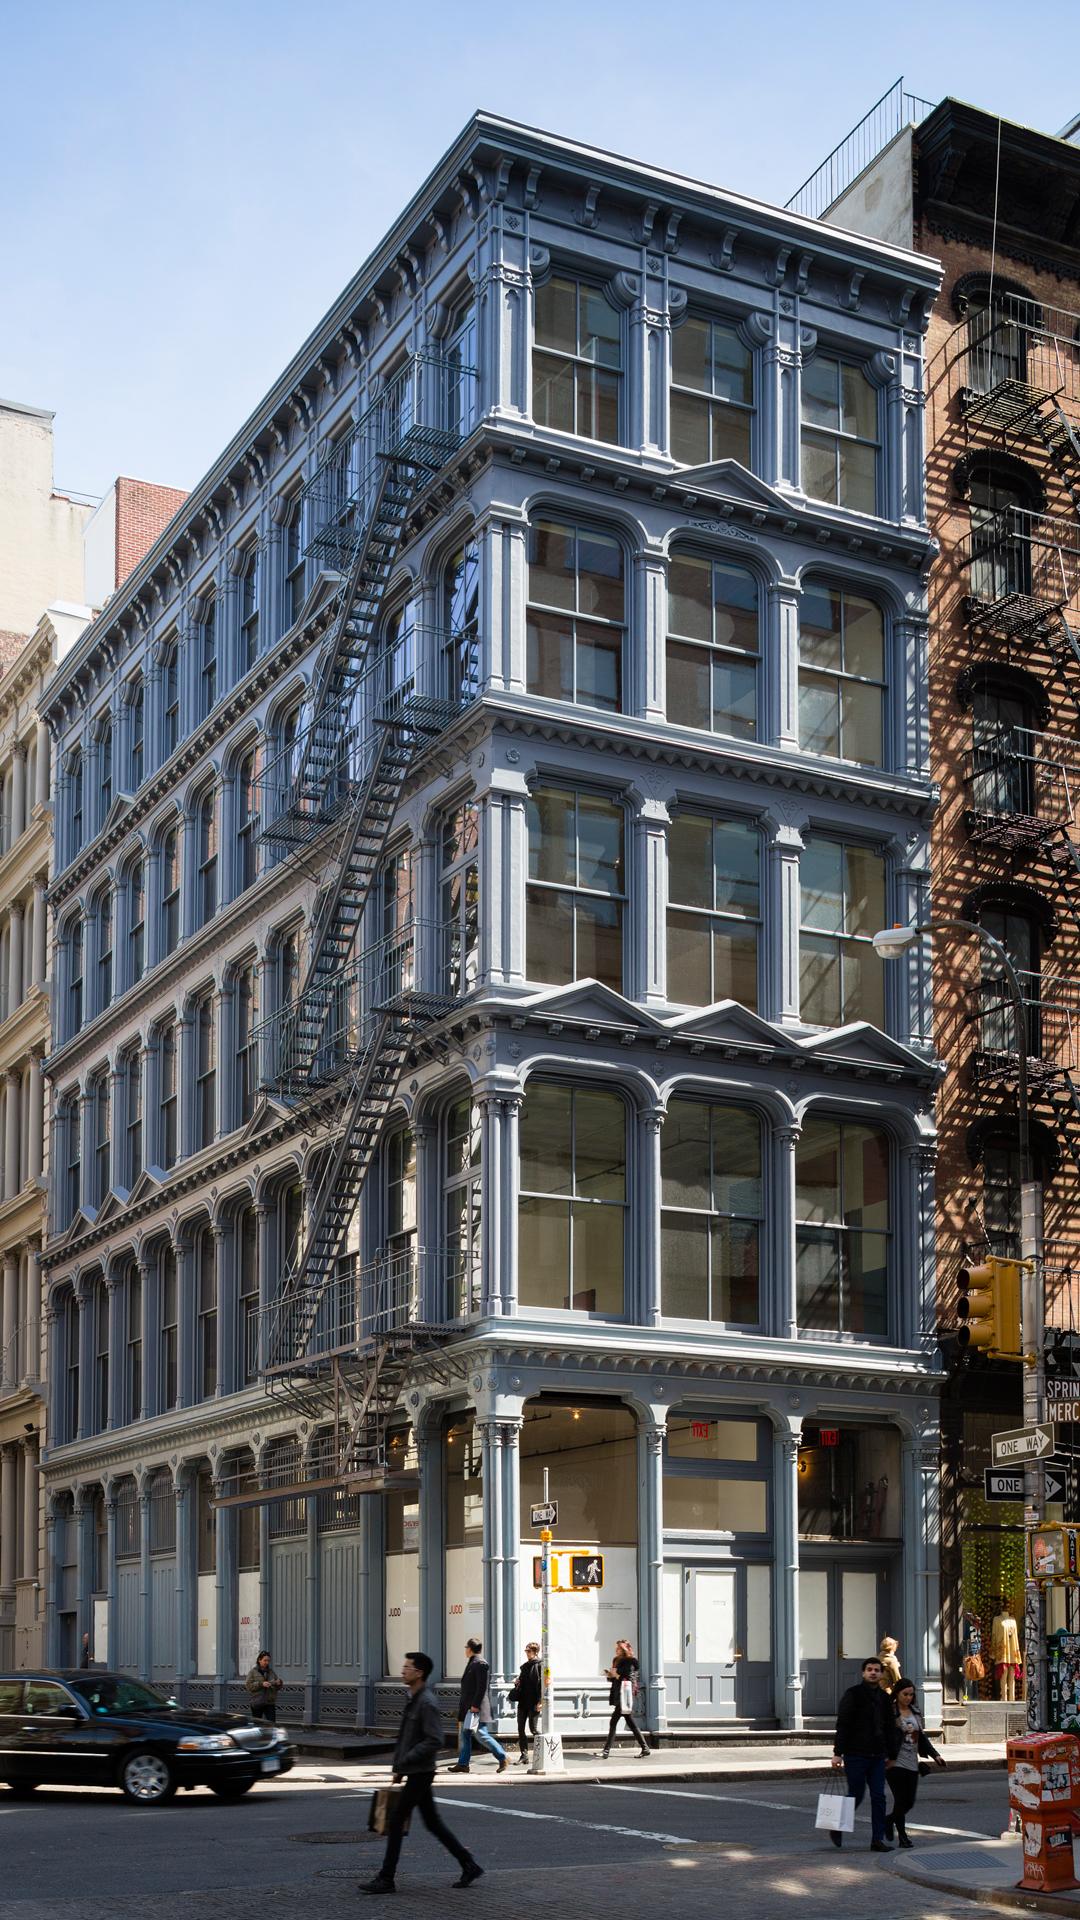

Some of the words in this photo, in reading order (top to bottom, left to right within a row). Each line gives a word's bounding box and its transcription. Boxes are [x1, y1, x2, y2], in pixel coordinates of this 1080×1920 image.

[1047, 1380, 1080, 1398] SPRIN
[1049, 1402, 1080, 1421] MERC
[1001, 1440, 1019, 1455] ONE
[1026, 1435, 1044, 1450] WAY
[997, 1479, 1020, 1492] ONE
[534, 1511, 543, 1521] ONE
[388, 1607, 402, 1617] JUDD
[448, 1604, 463, 1615] JUDD
